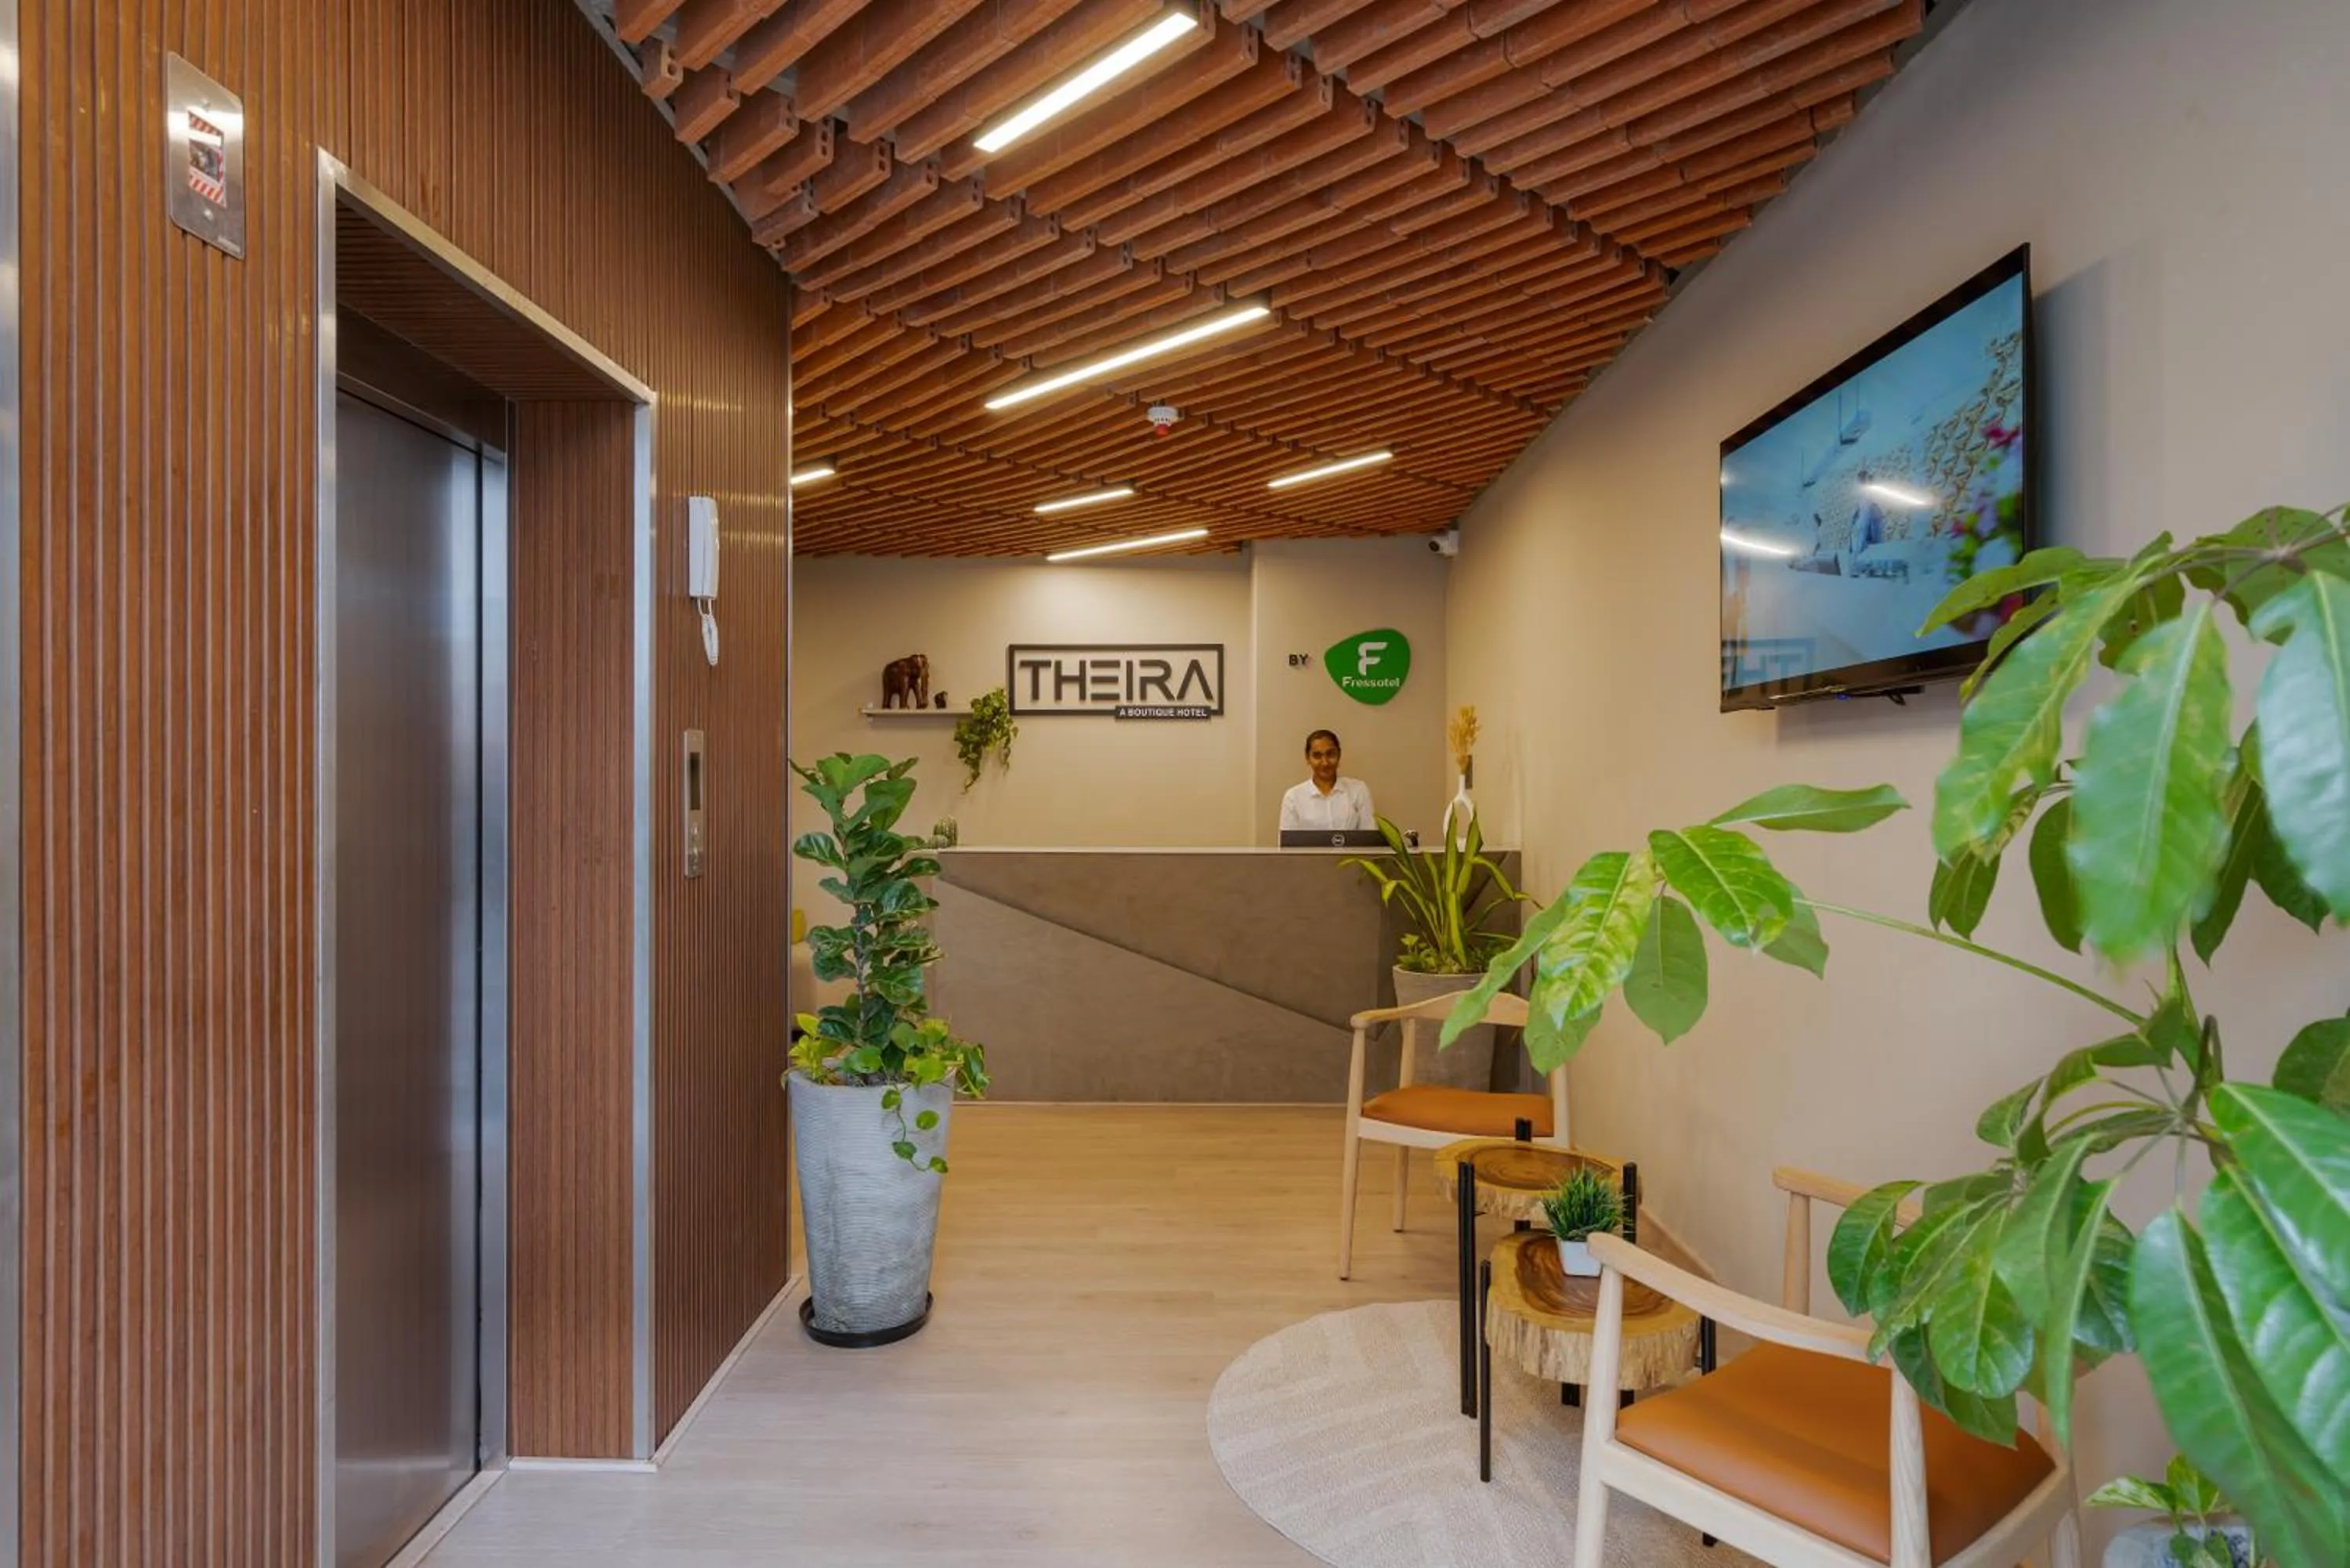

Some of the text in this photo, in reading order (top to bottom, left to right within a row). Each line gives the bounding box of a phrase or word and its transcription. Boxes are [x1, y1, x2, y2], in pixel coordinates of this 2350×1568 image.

[1289, 654, 1308, 666] BY
[1358, 641, 1388, 676] F
[1020, 659, 1213, 701] THEIRA
[1119, 707, 1207, 717] A BOUTIQUE HOTEL
